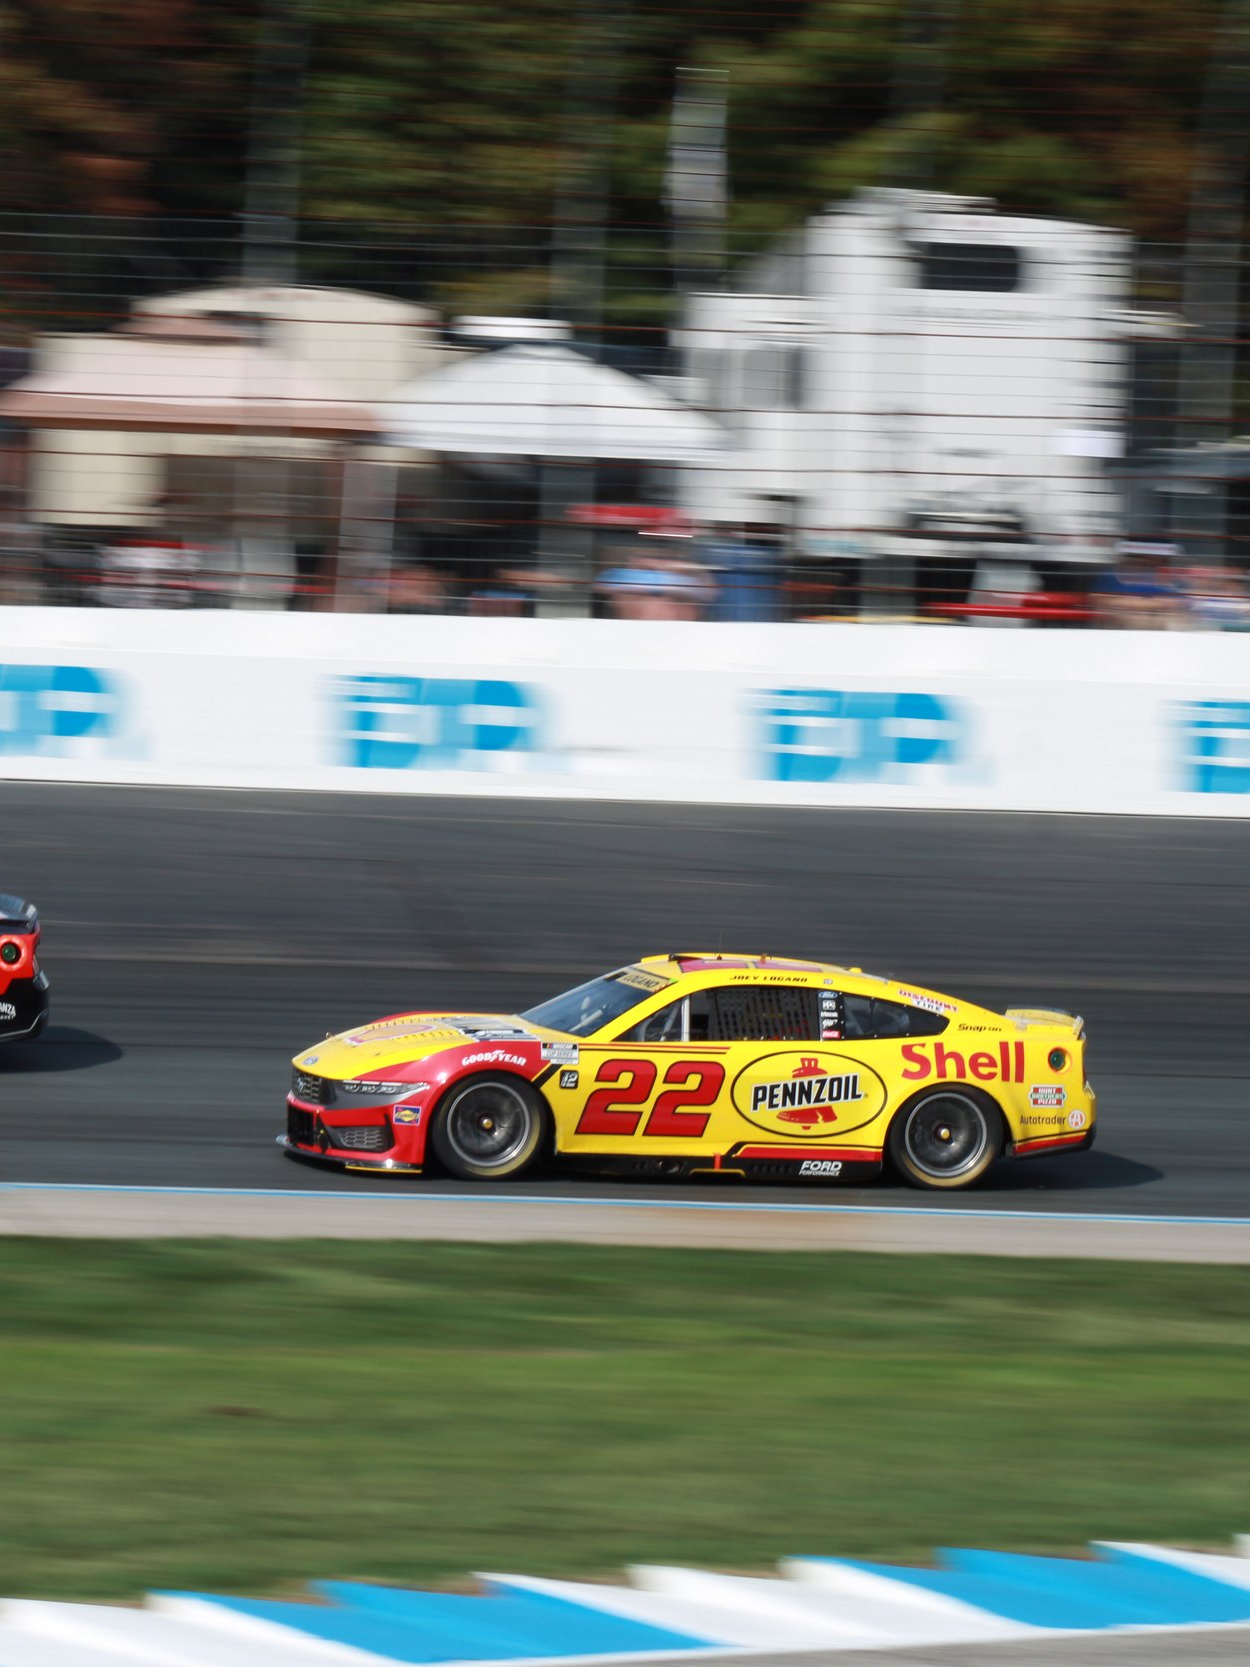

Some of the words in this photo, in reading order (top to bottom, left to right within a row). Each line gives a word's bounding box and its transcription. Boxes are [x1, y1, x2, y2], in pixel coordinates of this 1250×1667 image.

[461, 1049, 527, 1067] GOODYEAR
[901, 1041, 1025, 1084] Shell
[574, 1058, 726, 1138] 22
[751, 1074, 863, 1112] PENNZOIL
[1020, 1114, 1067, 1125] Autotrader
[801, 1160, 843, 1171] FORD
